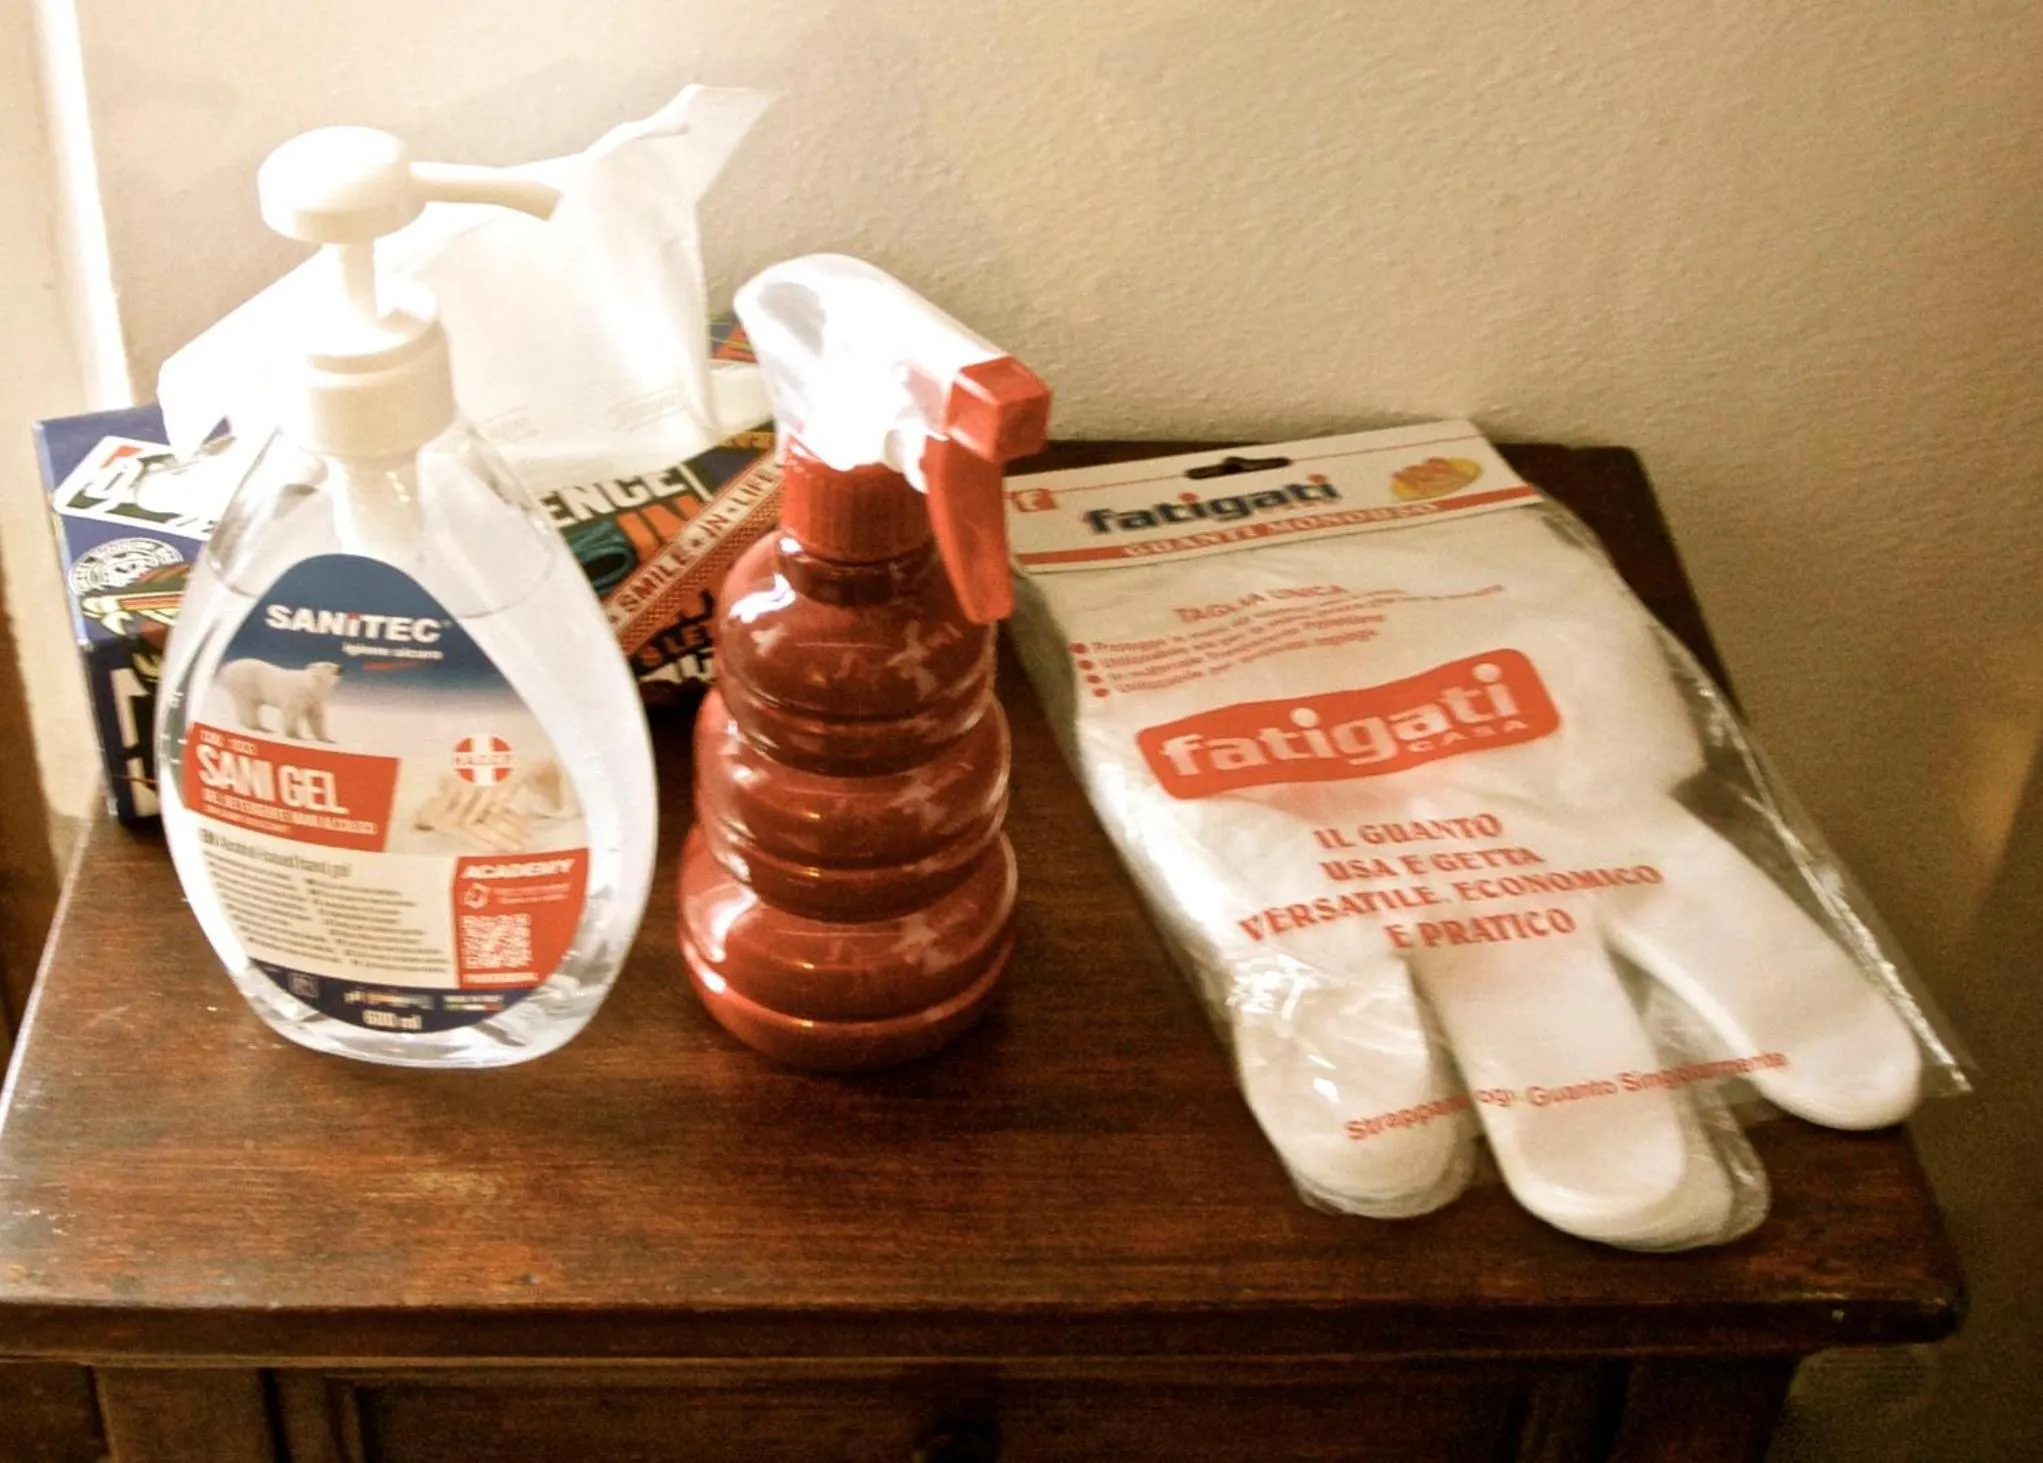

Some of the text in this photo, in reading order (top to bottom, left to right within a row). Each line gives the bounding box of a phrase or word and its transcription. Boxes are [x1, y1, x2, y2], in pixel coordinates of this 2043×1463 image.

[1082, 473, 1343, 535] fatigati
[1124, 526, 1258, 557] GUANTI
[1161, 663, 1520, 777] fatigati
[1407, 719, 1530, 753] CASA
[195, 743, 276, 803] SANI
[278, 764, 350, 815] GEL
[1312, 813, 1504, 850] IL GUANTO
[460, 857, 577, 880] ACADEMY
[1319, 846, 1545, 882] USA E GETTA
[1449, 864, 1664, 902] ECONOMICO
[1382, 907, 1577, 950] E PRATICO
[1526, 1079, 1618, 1107] Guanto
